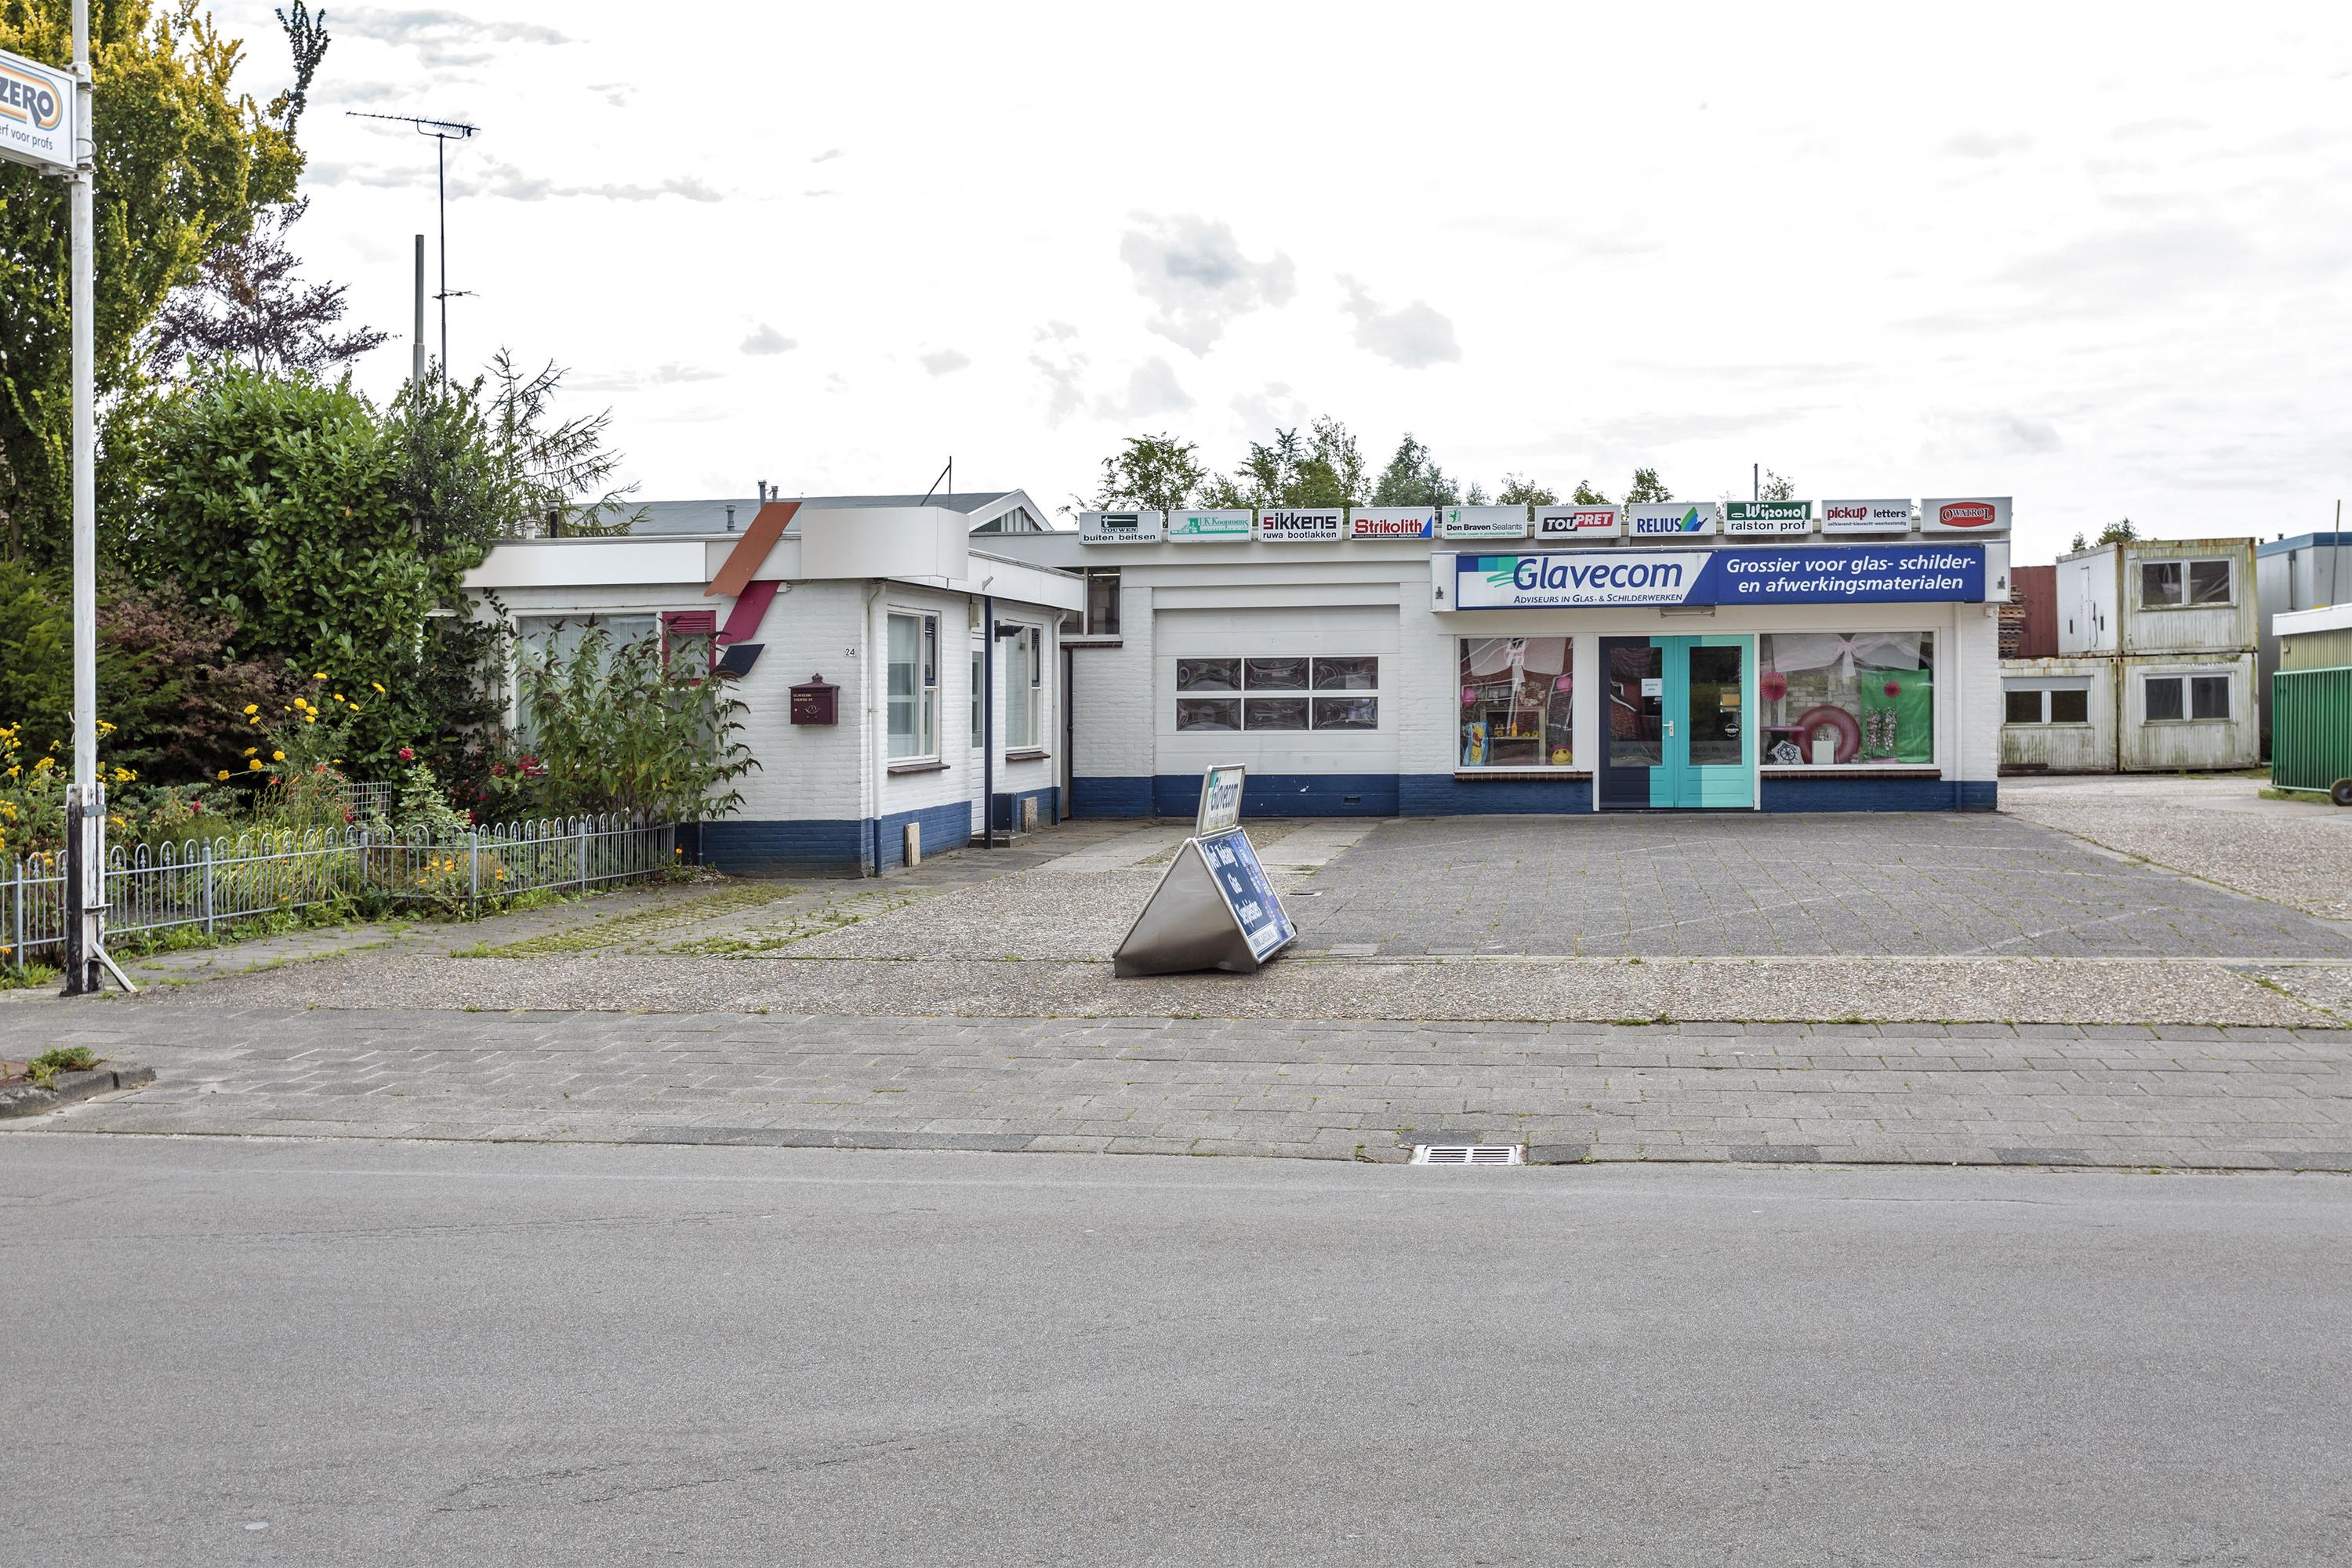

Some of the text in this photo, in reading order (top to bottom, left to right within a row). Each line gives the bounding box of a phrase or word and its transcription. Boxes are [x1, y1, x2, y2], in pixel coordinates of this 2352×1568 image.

[11, 129, 30, 143] voor
[32, 136, 53, 151] profs
[1263, 513, 1337, 530] sikkens
[1828, 506, 1907, 521] pickup letters
[1942, 508, 1993, 521] OWATROL
[1355, 519, 1422, 534] Strikolith
[1637, 517, 1682, 532] RELIUS
[1731, 520, 1806, 531] ralston prof
[1726, 554, 1976, 575] Grossier voor glas- schilder-
[1513, 557, 1682, 590] Glavecom
[1738, 574, 1963, 595] en afwerkingsmaterialen
[1514, 595, 1559, 604] ADVISEURS
[1607, 593, 1682, 602] SCHILDERWERKEN
[1210, 776, 1239, 811] Glavecom
